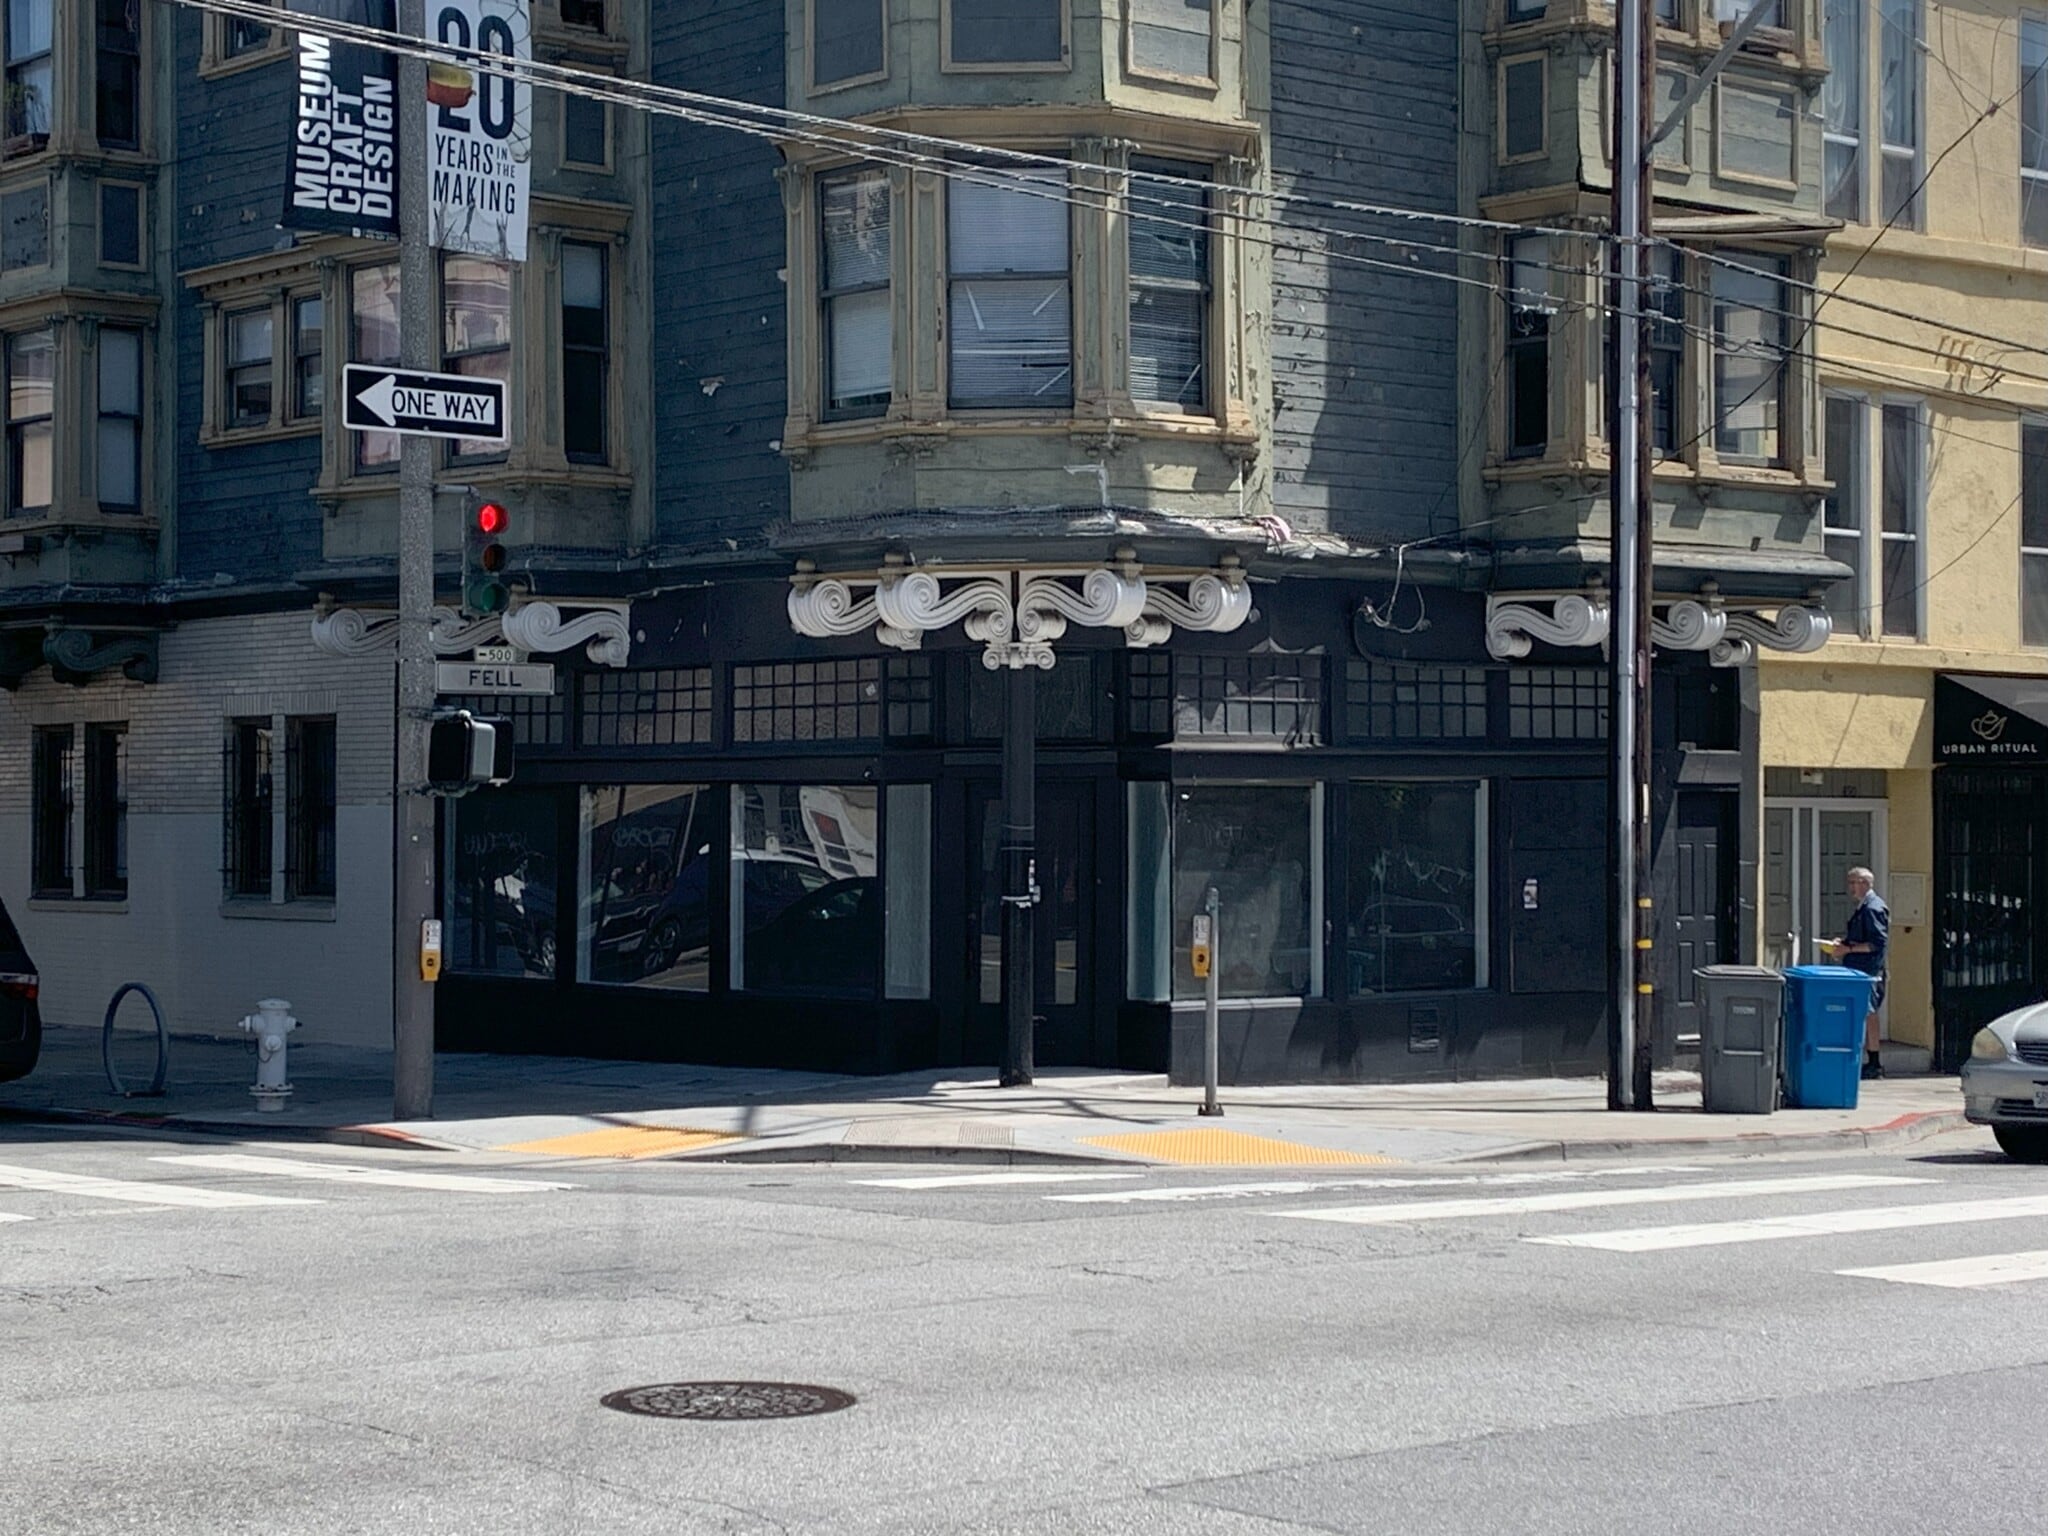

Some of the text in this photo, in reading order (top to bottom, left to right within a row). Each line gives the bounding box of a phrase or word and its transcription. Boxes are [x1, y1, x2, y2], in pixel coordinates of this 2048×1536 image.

[438, 6, 514, 140] 20
[293, 32, 332, 210] MUSEUM
[328, 85, 364, 214] CRAFT
[361, 75, 393, 218] DESIGN
[435, 133, 494, 175] YEARS
[496, 147, 508, 160] IN
[497, 163, 516, 179] THE
[433, 170, 516, 215] MAKING
[391, 389, 490, 421] ONE WAY
[469, 670, 522, 687] FELL
[1942, 743, 2038, 754] URBAN RITUAL
